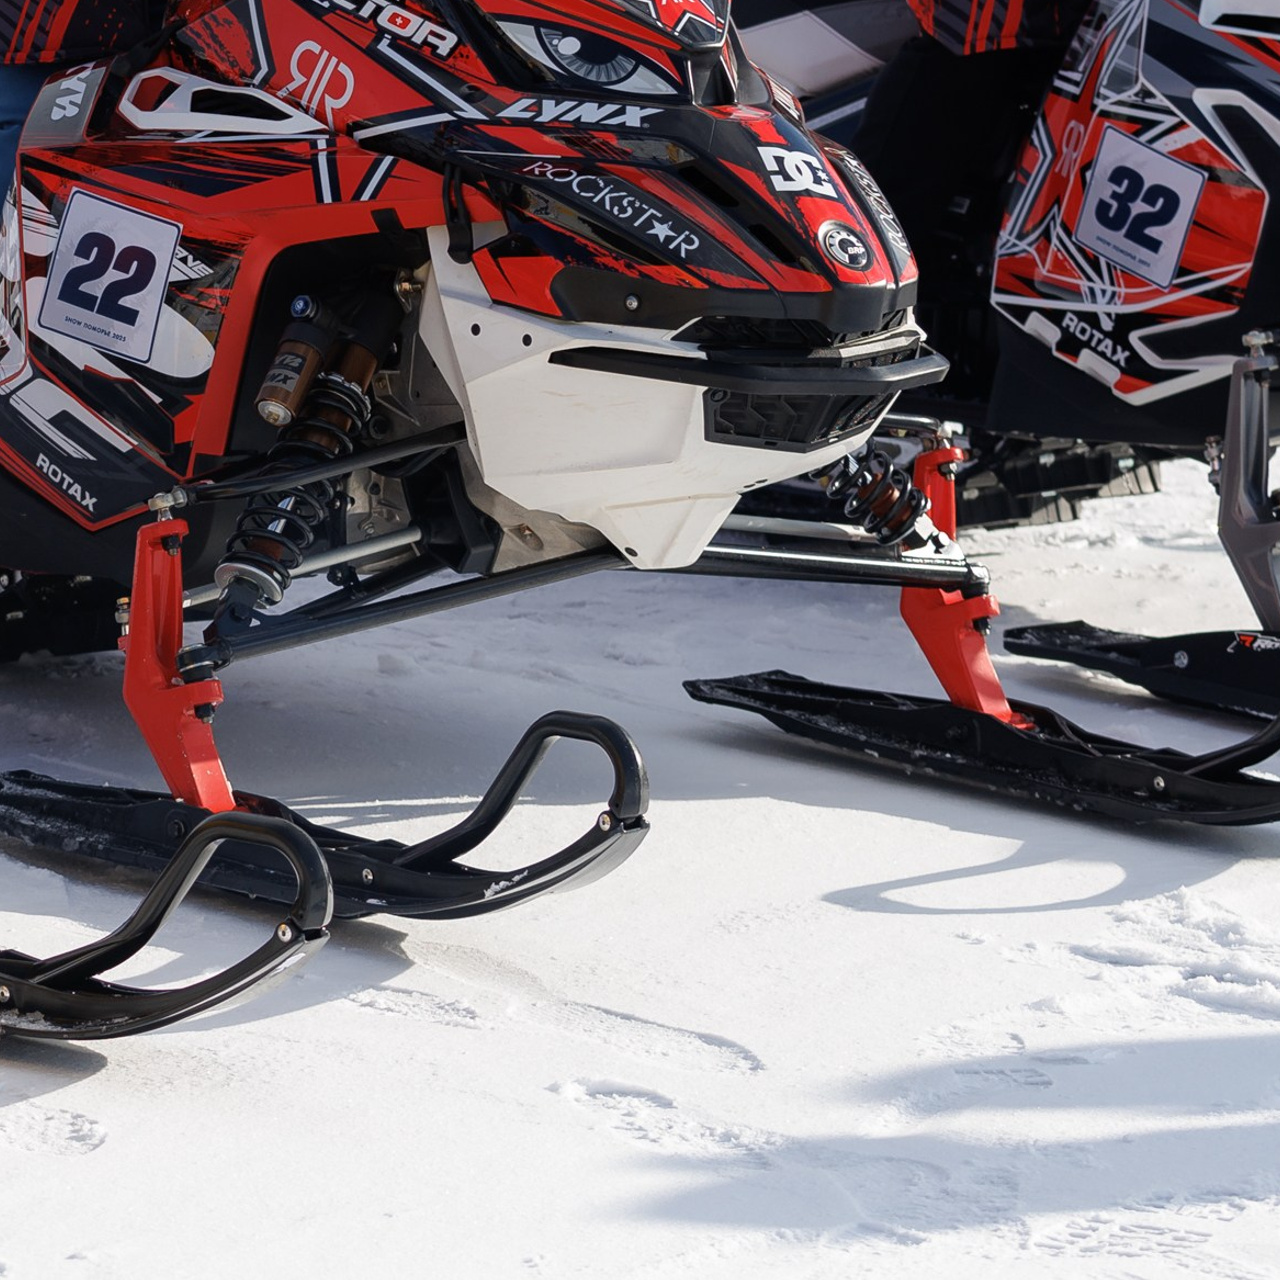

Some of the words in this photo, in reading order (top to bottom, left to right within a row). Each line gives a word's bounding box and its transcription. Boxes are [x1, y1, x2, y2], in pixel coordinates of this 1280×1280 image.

[496, 98, 664, 128] LYNX
[1094, 164, 1182, 255] 32
[57, 231, 157, 327] 22
[173, 246, 214, 277] AVE
[1061, 312, 1129, 368] ROTAX
[35, 452, 98, 514] ROTAX
